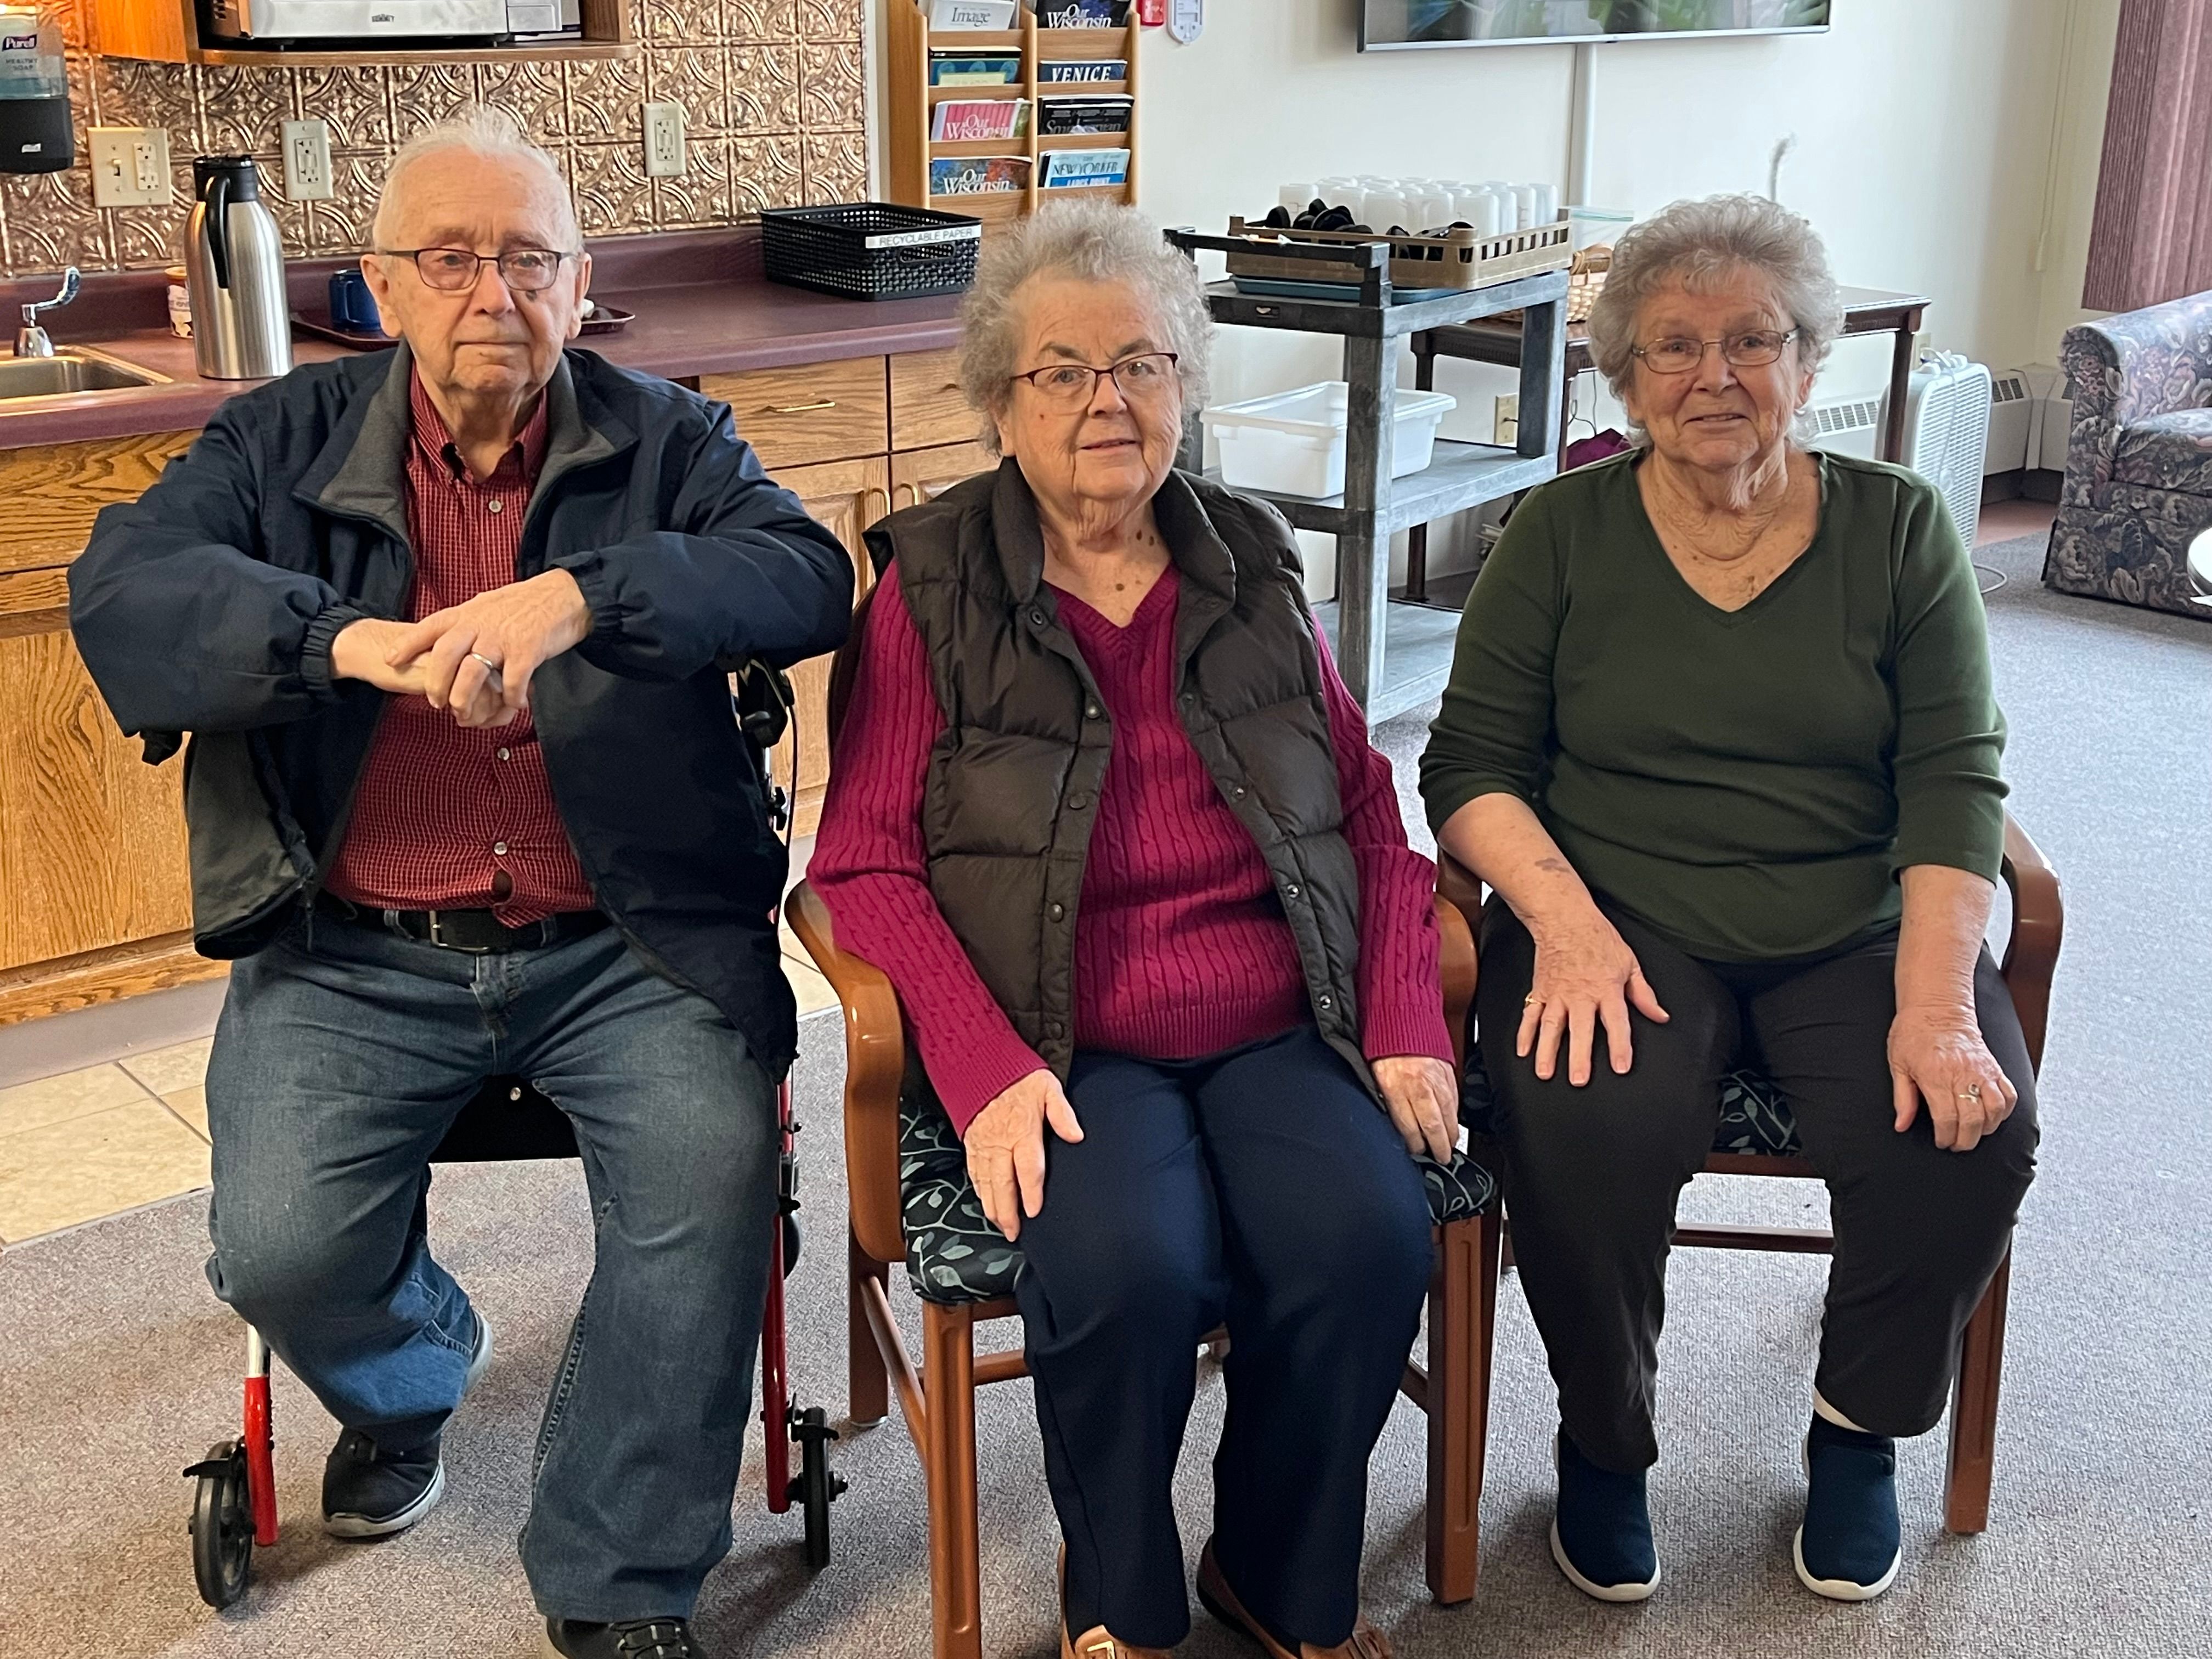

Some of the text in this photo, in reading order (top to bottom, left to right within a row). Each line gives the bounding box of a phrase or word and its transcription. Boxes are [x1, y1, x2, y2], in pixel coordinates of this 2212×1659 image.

[951, 7, 991, 27] Image
[1066, 4, 1090, 18] Our
[1047, 12, 1112, 28] Wisconsin
[1052, 66, 1111, 82] VENICE
[966, 114, 989, 128] Our
[963, 169, 987, 183] Our
[943, 177, 1010, 194] Wisconsin
[879, 228, 973, 246] RECYCLABLE PAPER
